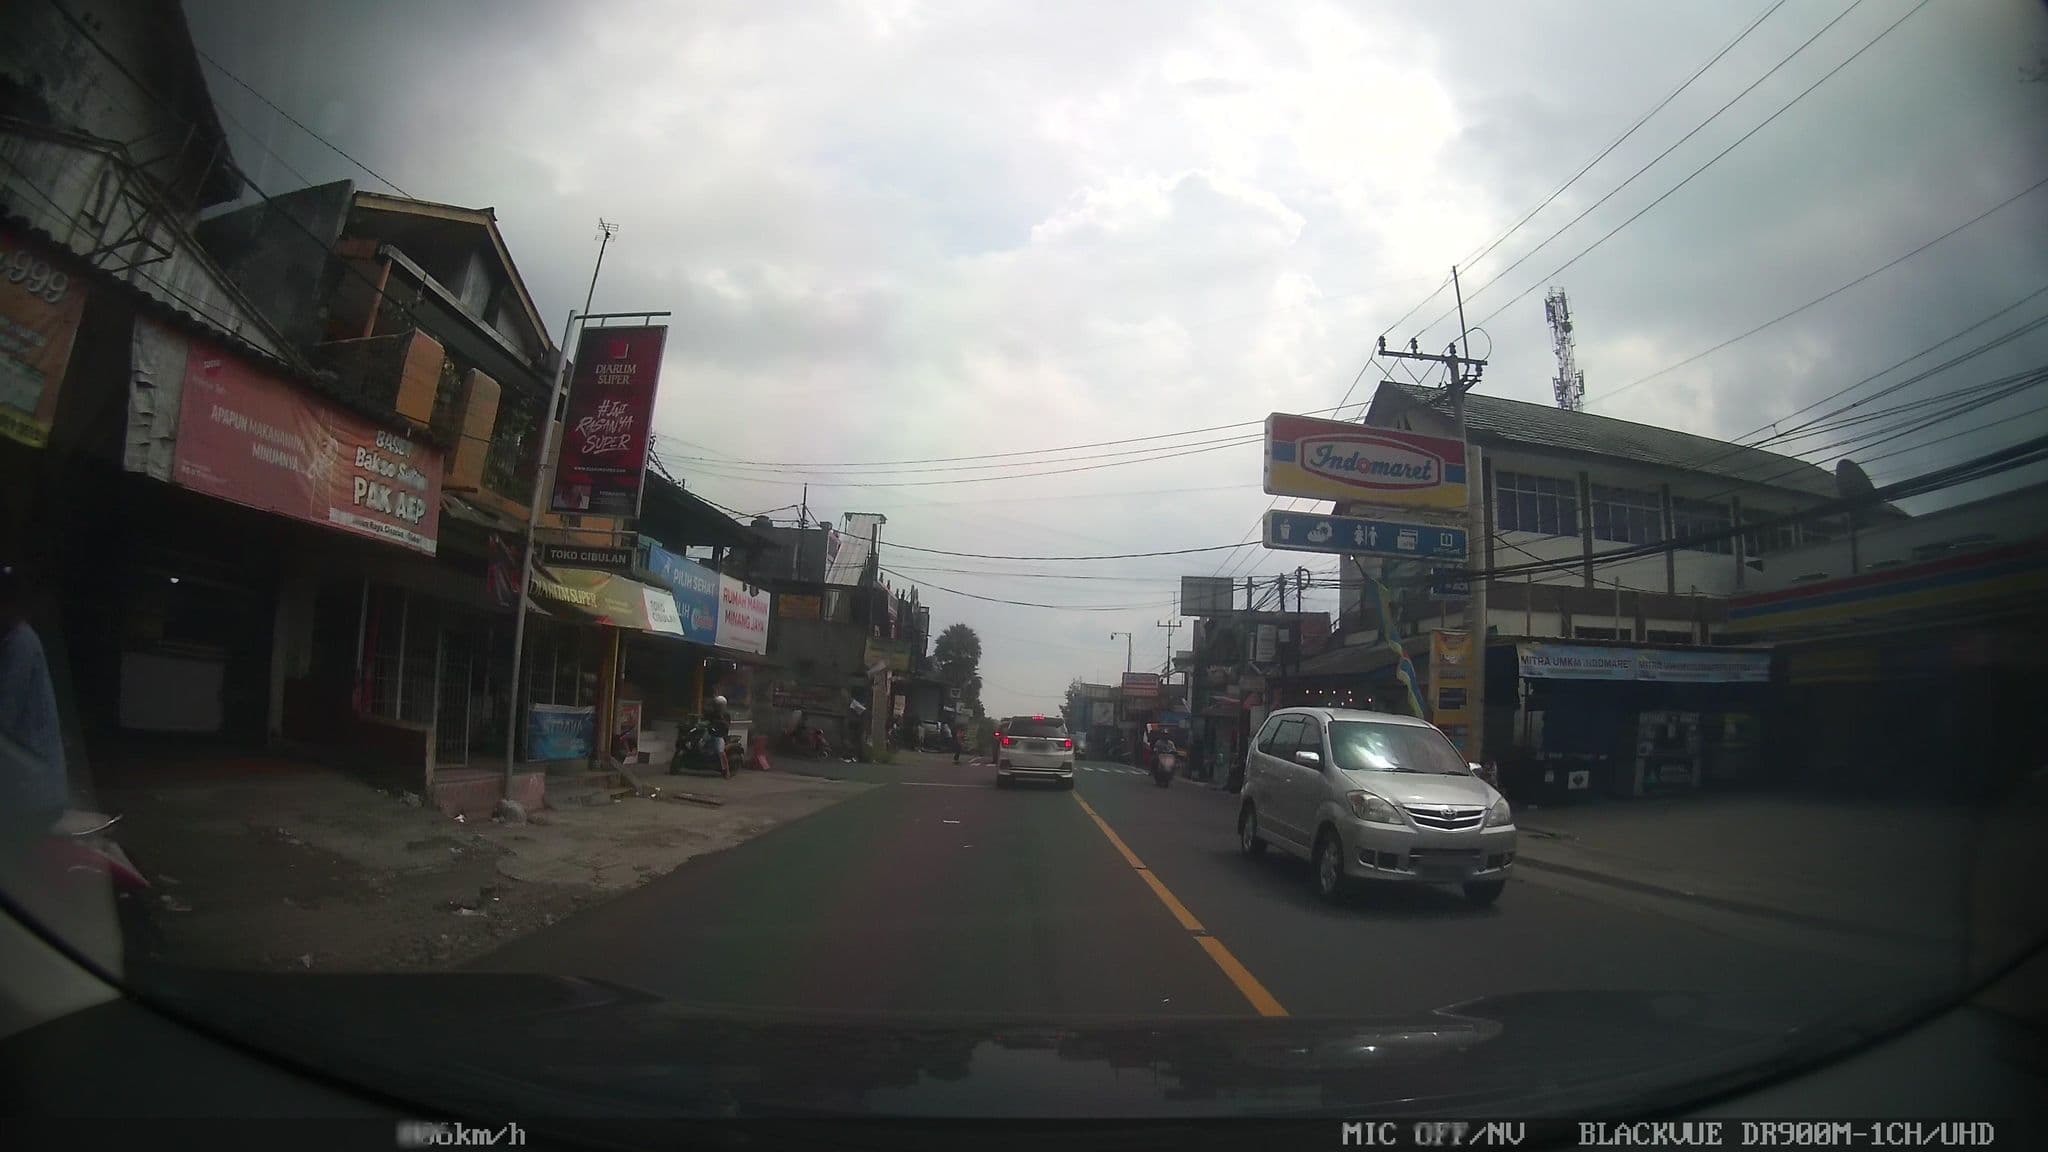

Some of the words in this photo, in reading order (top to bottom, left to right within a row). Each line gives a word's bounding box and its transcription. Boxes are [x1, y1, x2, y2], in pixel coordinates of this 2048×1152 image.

[596, 363, 636, 374] DJARUM
[598, 375, 630, 385] SUPER
[211, 404, 248, 432] APAPUN
[582, 435, 632, 454] SUPER
[1310, 444, 1433, 481] Indomaret
[353, 476, 392, 514] PAK
[551, 549, 578, 561] TOKO
[581, 552, 627, 564] CIBULAN
[1520, 655, 1550, 667] MITRA
